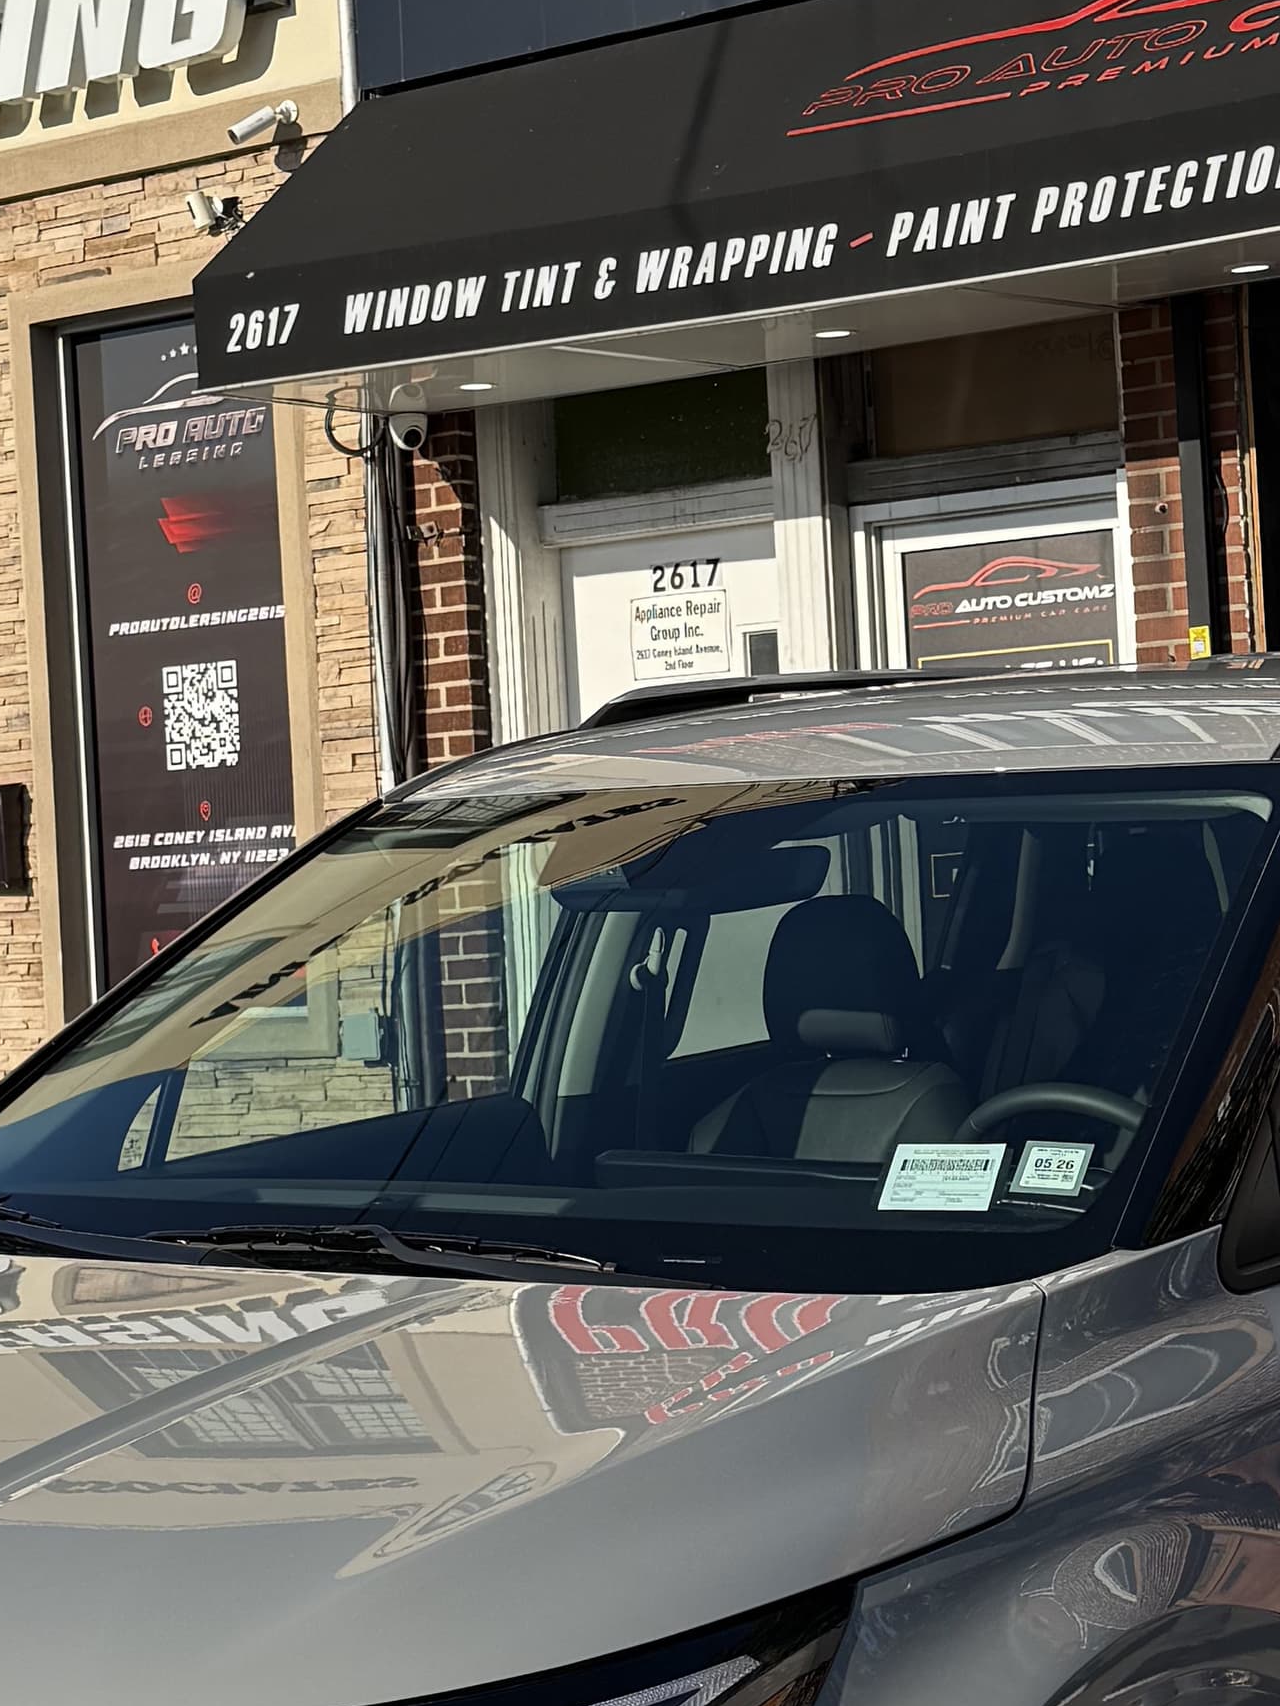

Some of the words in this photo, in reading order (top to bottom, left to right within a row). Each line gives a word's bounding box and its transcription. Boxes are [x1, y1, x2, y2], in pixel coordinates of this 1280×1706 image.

[801, 64, 972, 117] PRO
[976, 19, 1209, 85] AUTO
[1021, 33, 1280, 98] PREMIUM
[226, 303, 299, 353] 2617
[344, 275, 487, 334] WINDOW
[501, 260, 582, 313] TINT
[594, 257, 618, 300] &
[635, 222, 839, 293] WRAPPING
[886, 192, 1016, 257] PAINT
[116, 421, 177, 453] PRO
[183, 407, 266, 443] AUTO
[139, 442, 243, 470] LEASING
[653, 558, 720, 592] 2617
[635, 604, 682, 624] Appliance
[686, 597, 721, 617] Repair
[911, 602, 953, 618] PRO
[954, 595, 1013, 614] AUTO
[1014, 583, 1115, 608] CUSTOMZ
[973, 612, 1032, 625] PREMIUM
[1040, 609, 1066, 618] CAR
[1074, 604, 1109, 614] CARE
[109, 605, 286, 636] PROAUTOLEASING2615
[650, 625, 680, 643] Group
[684, 622, 704, 638] Inc.
[114, 834, 151, 849] 2615
[154, 830, 205, 846] CONEY
[209, 826, 267, 843] ISLAND
[271, 824, 297, 839] AV
[220, 850, 241, 866] NY
[1034, 1157, 1053, 1170] 05
[1055, 1158, 1076, 1171] 26
